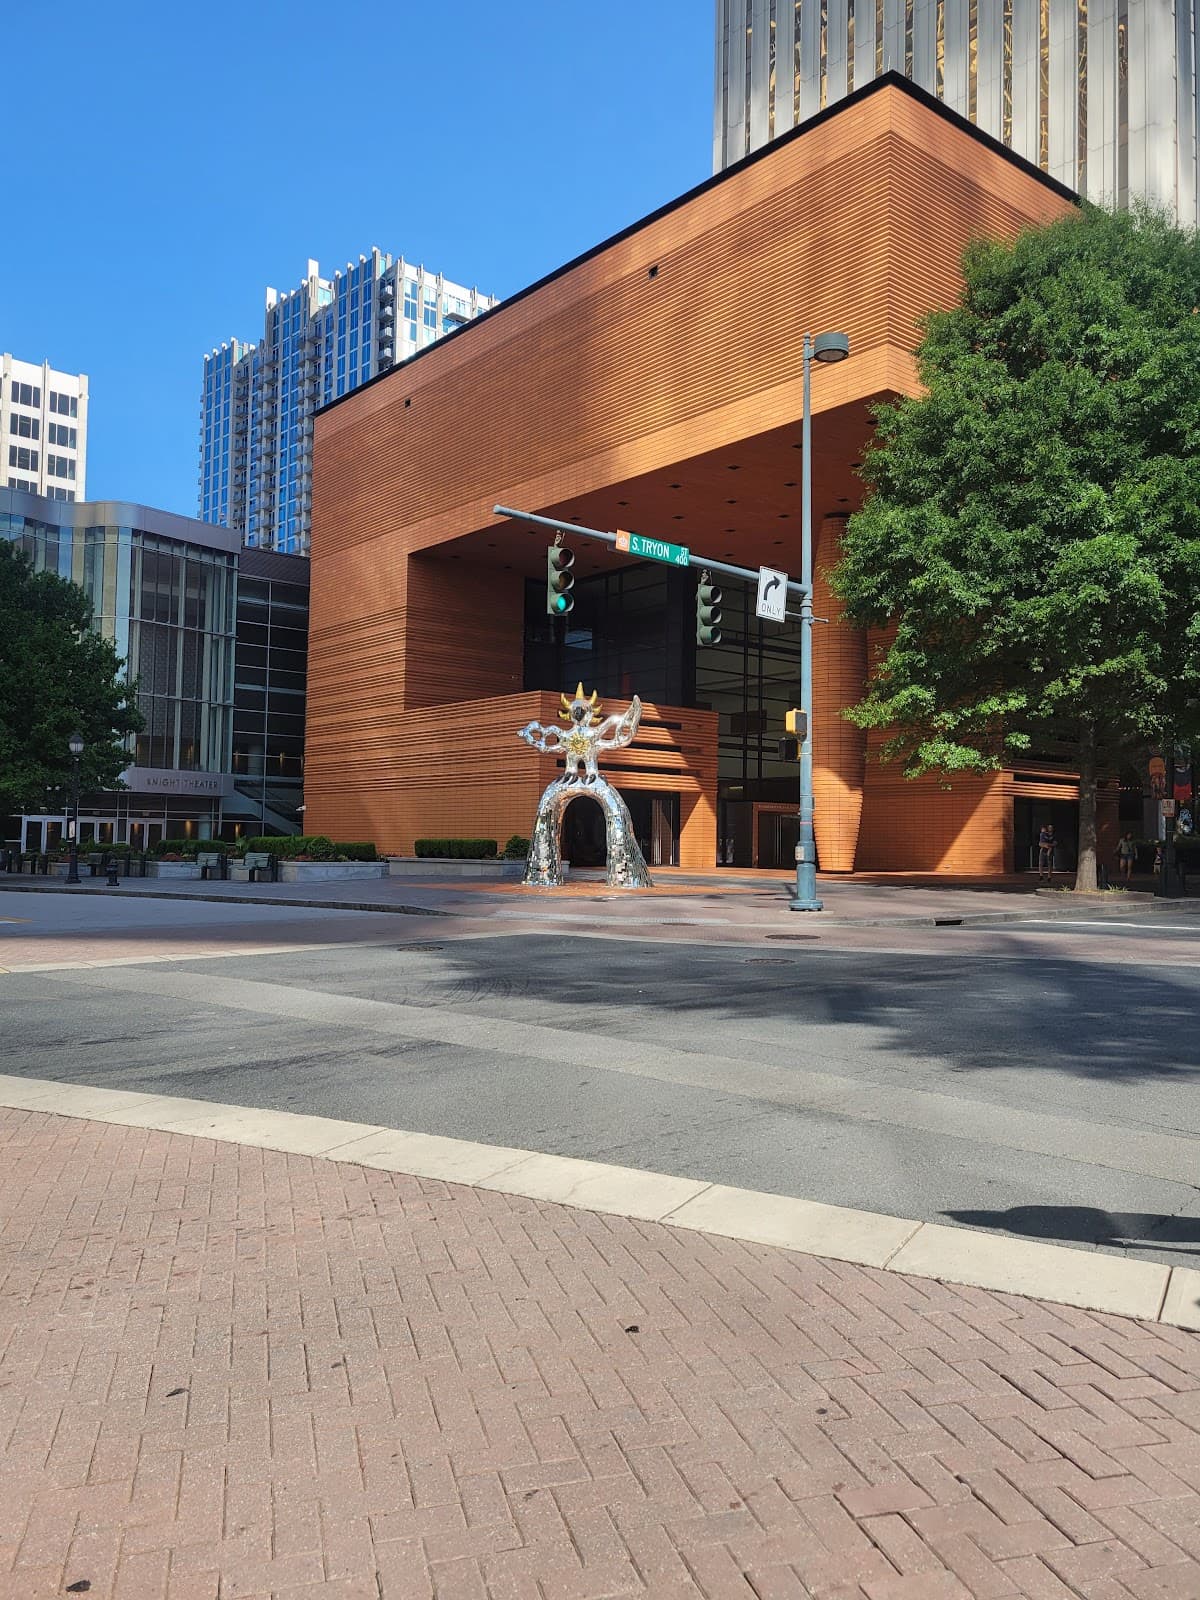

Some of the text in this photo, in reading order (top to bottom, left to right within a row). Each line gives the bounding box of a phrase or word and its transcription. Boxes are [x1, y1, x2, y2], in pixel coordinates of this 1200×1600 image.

[632, 536, 670, 559] S. TRYON
[675, 555, 689, 566] 400
[761, 603, 781, 616] ONLY
[147, 777, 218, 789] KNIGHT THEATER
